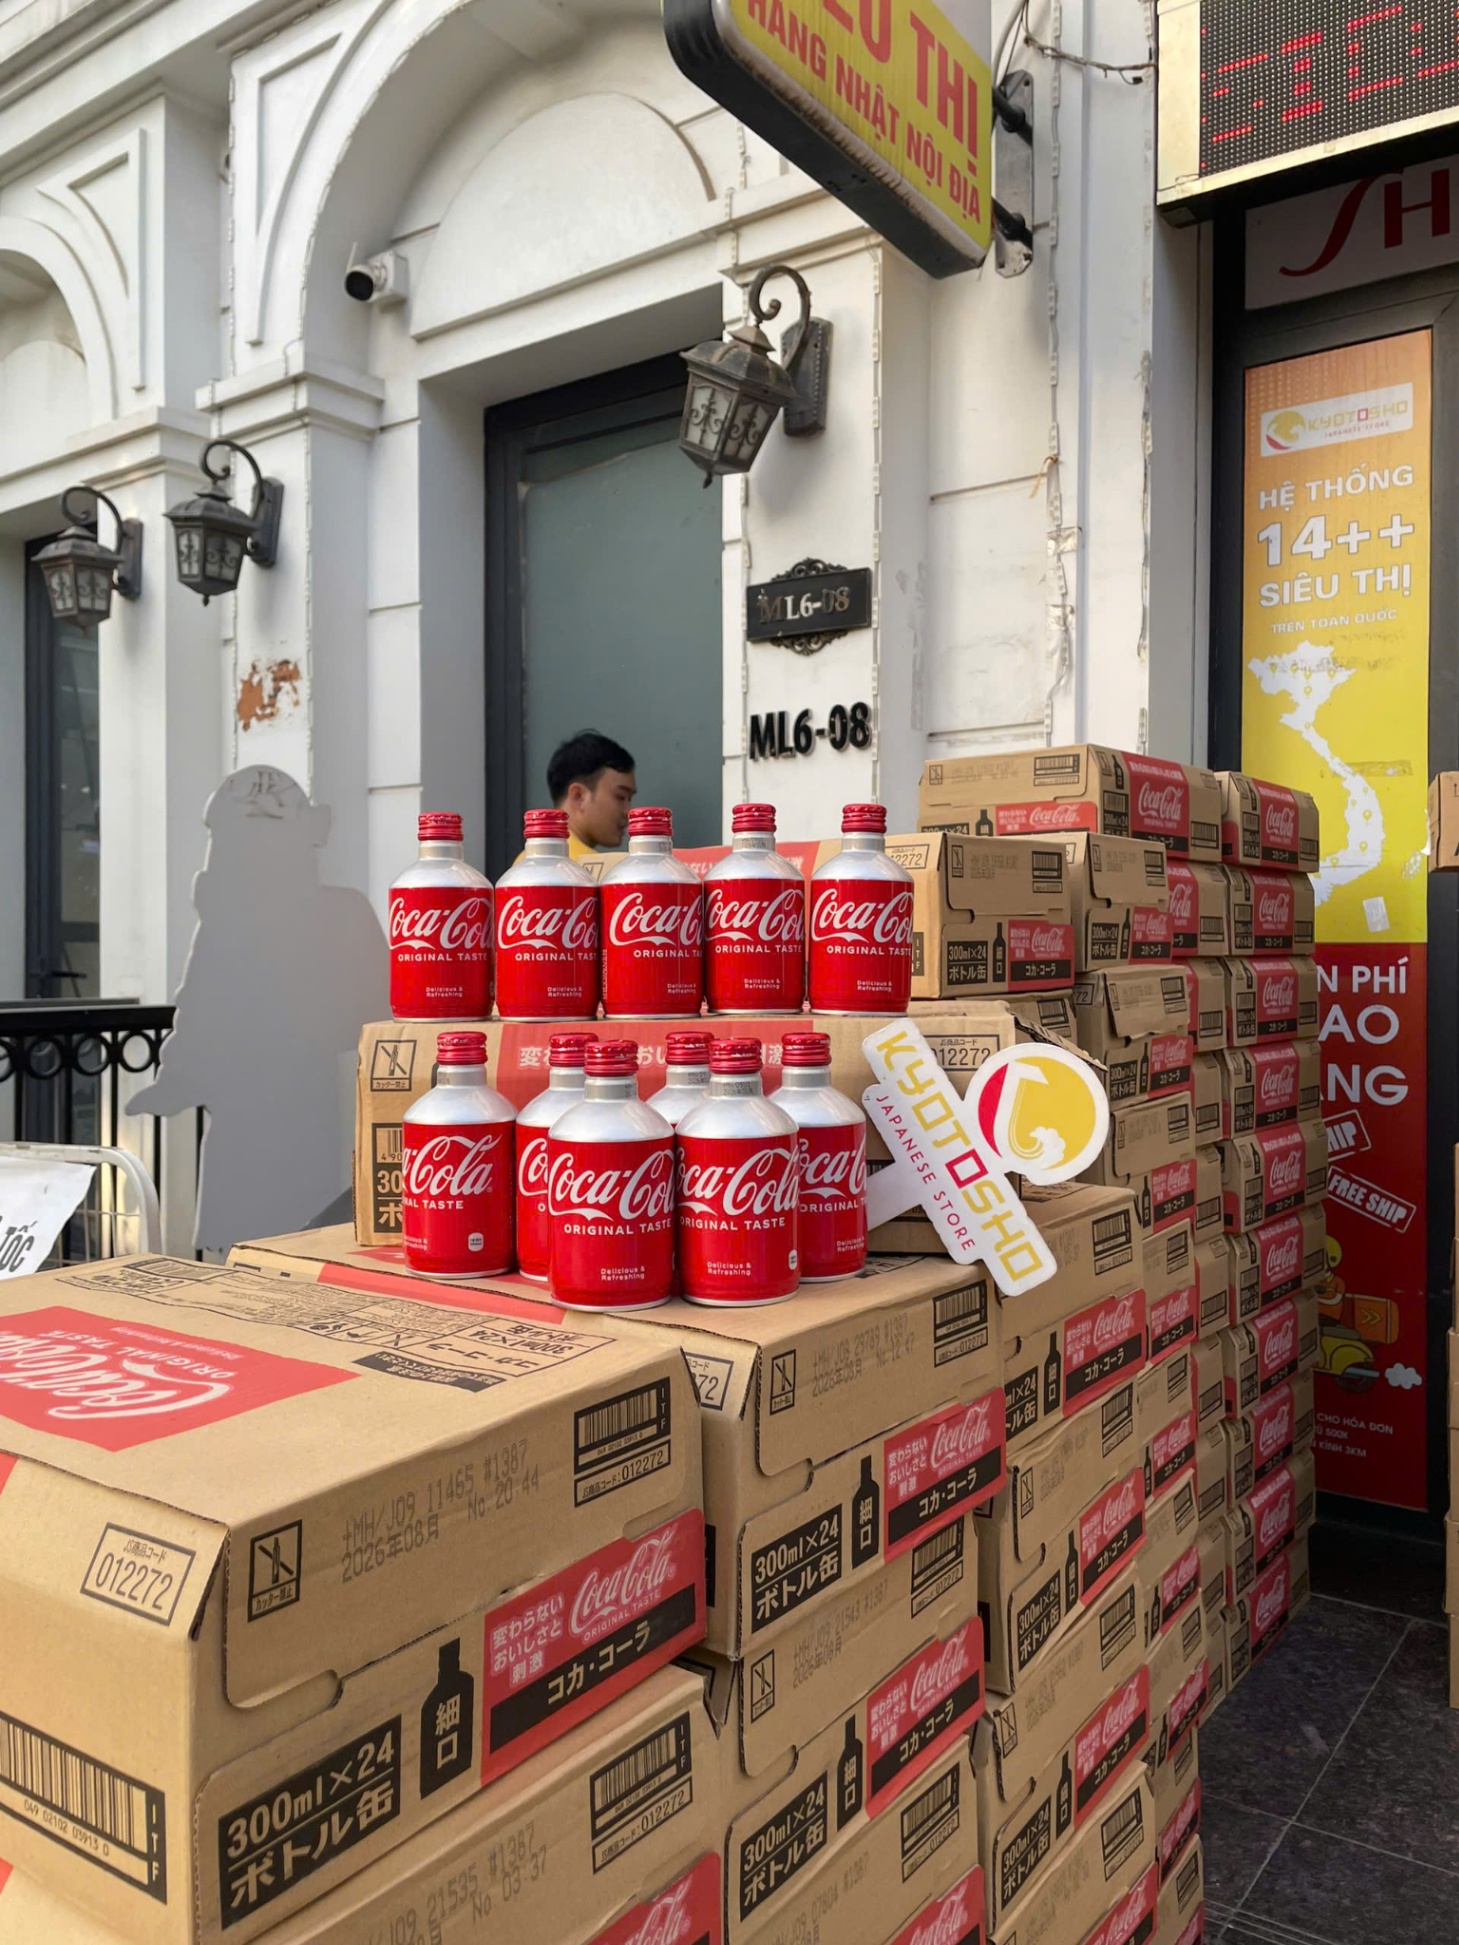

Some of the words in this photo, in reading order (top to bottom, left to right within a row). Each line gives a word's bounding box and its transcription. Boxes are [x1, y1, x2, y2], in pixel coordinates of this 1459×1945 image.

[819, 0, 892, 64] U
[909, 10, 979, 177] THỊ
[835, 53, 900, 145] NHẬT
[906, 122, 943, 188] NỘI
[949, 163, 981, 225] ĐỊA
[1307, 400, 1409, 432] KYOTOSHO
[1259, 480, 1295, 512] HỆ
[1305, 462, 1414, 501] THỐNG
[1257, 513, 1415, 567] 14++
[758, 586, 850, 624] ML6-08
[1259, 571, 1339, 608] SIÊU
[1352, 563, 1412, 597] THỊ
[1355, 607, 1397, 624] QUỐC
[750, 701, 871, 762] ML6-08
[1029, 804, 1081, 824] Coca-Cola
[1138, 781, 1183, 823] Coca-Cola
[1265, 804, 1295, 840] Coca-Cola
[389, 897, 494, 950] Coca-Col
[704, 888, 805, 942] Coca-Col
[811, 888, 914, 943] Coca-Col
[1259, 891, 1291, 926] Coca-Cola
[398, 952, 453, 962] ORIGINAL
[457, 952, 488, 962] TASTE
[515, 952, 574, 962] ORIGINAL
[633, 949, 690, 958] ORIGINAL
[715, 944, 771, 953] ORIGINAL
[775, 944, 802, 953] TASTE
[826, 945, 885, 955] ORIGINAL
[948, 945, 987, 960] 300ml×24
[1031, 927, 1065, 953] Coca-Cola
[948, 965, 987, 981] ボトル缶
[1025, 963, 1057, 977] コカ・コーラ
[1351, 956, 1409, 994] PHÍ
[1262, 976, 1295, 1009] Coca-Cola
[1261, 1064, 1296, 1100] Coca-Cola
[1319, 1062, 1409, 1107] NG
[876, 1031, 1043, 1282] KYOTOSHO
[876, 1095, 937, 1185] JAPANESE
[933, 1190, 975, 1251] STORE
[1270, 1151, 1302, 1190] Coca-Cola
[422, 1199, 464, 1210] TASTE
[548, 1149, 675, 1222] Coca-Col
[800, 1200, 858, 1213] ORIGINAL
[1328, 1173, 1365, 1208] FREE
[1365, 1191, 1407, 1226] SHIP
[564, 1223, 634, 1236] ORIGINAL
[639, 1218, 671, 1234] TASTE
[680, 1217, 738, 1231] ORIGINAL
[744, 1216, 786, 1230] TASTE
[600, 1267, 638, 1275] Delicious
[600, 1273, 645, 1281] Refreshing
[707, 1261, 745, 1269] Delicious
[707, 1268, 751, 1276] Refreshing
[1266, 1234, 1299, 1277] Coca-Cola
[39, 1329, 118, 1350] TASTE
[468, 1329, 574, 1356] 300ml×24
[1093, 1297, 1135, 1345] Coca-Cola
[121, 1346, 237, 1379] ORIGINAL
[425, 1343, 540, 1369] コカ・コーラ
[1085, 1348, 1125, 1382] コカ・コーラ
[931, 1397, 990, 1470] Coca-Cola
[1316, 1412, 1341, 1426] CHO
[1343, 1413, 1367, 1431] HÓA
[1325, 1427, 1349, 1440] 500K
[888, 1437, 928, 1467] 変わらない
[888, 1454, 928, 1486] おいしさと
[1345, 1444, 1367, 1458] 3KM
[426, 1463, 475, 1514] 11465
[484, 1437, 529, 1484] #1387
[918, 1467, 978, 1518] コカ・コーラ
[859, 1496, 873, 1550] 細口
[1103, 1478, 1136, 1534] Coca-Cola
[340, 1514, 440, 1584] 2026年08月
[754, 1513, 839, 1584] 300ml×24
[1097, 1530, 1129, 1573] コカ・コーラ
[95, 1551, 174, 1611] 012272
[255, 1587, 294, 1612] カッター禁止
[570, 1523, 679, 1635] Coca-Cola
[756, 1552, 839, 1620] ボトル缶
[492, 1596, 564, 1648] 変わらない
[583, 1610, 630, 1641] ORIGINAL
[632, 1589, 661, 1613] TASTE
[1018, 1575, 1059, 1635] 300ml×24
[493, 1620, 563, 1672] おいしさと
[511, 1652, 544, 1682] 刺激
[547, 1620, 651, 1705] コカ・コーラ
[910, 1627, 968, 1711] Coca-Cola
[870, 1682, 909, 1721] 変わらない
[870, 1701, 908, 1742] おいしさと
[1102, 1671, 1139, 1746] Coca-Cola
[435, 1694, 461, 1770] 細口
[899, 1697, 955, 1763] コカ・コーラ
[1094, 1734, 1131, 1786] コカ・コーラ
[227, 1730, 395, 1860] 300ml×24
[843, 1755, 857, 1811] 細口
[151, 1803, 160, 1882] ITF
[230, 1784, 394, 1909] ボトル缶
[743, 1781, 825, 1872] 300ml×24
[1002, 1803, 1050, 1873] 300ml×24
[744, 1818, 825, 1907] ボトル缶
[1002, 1834, 1050, 1900] ボトル缶
